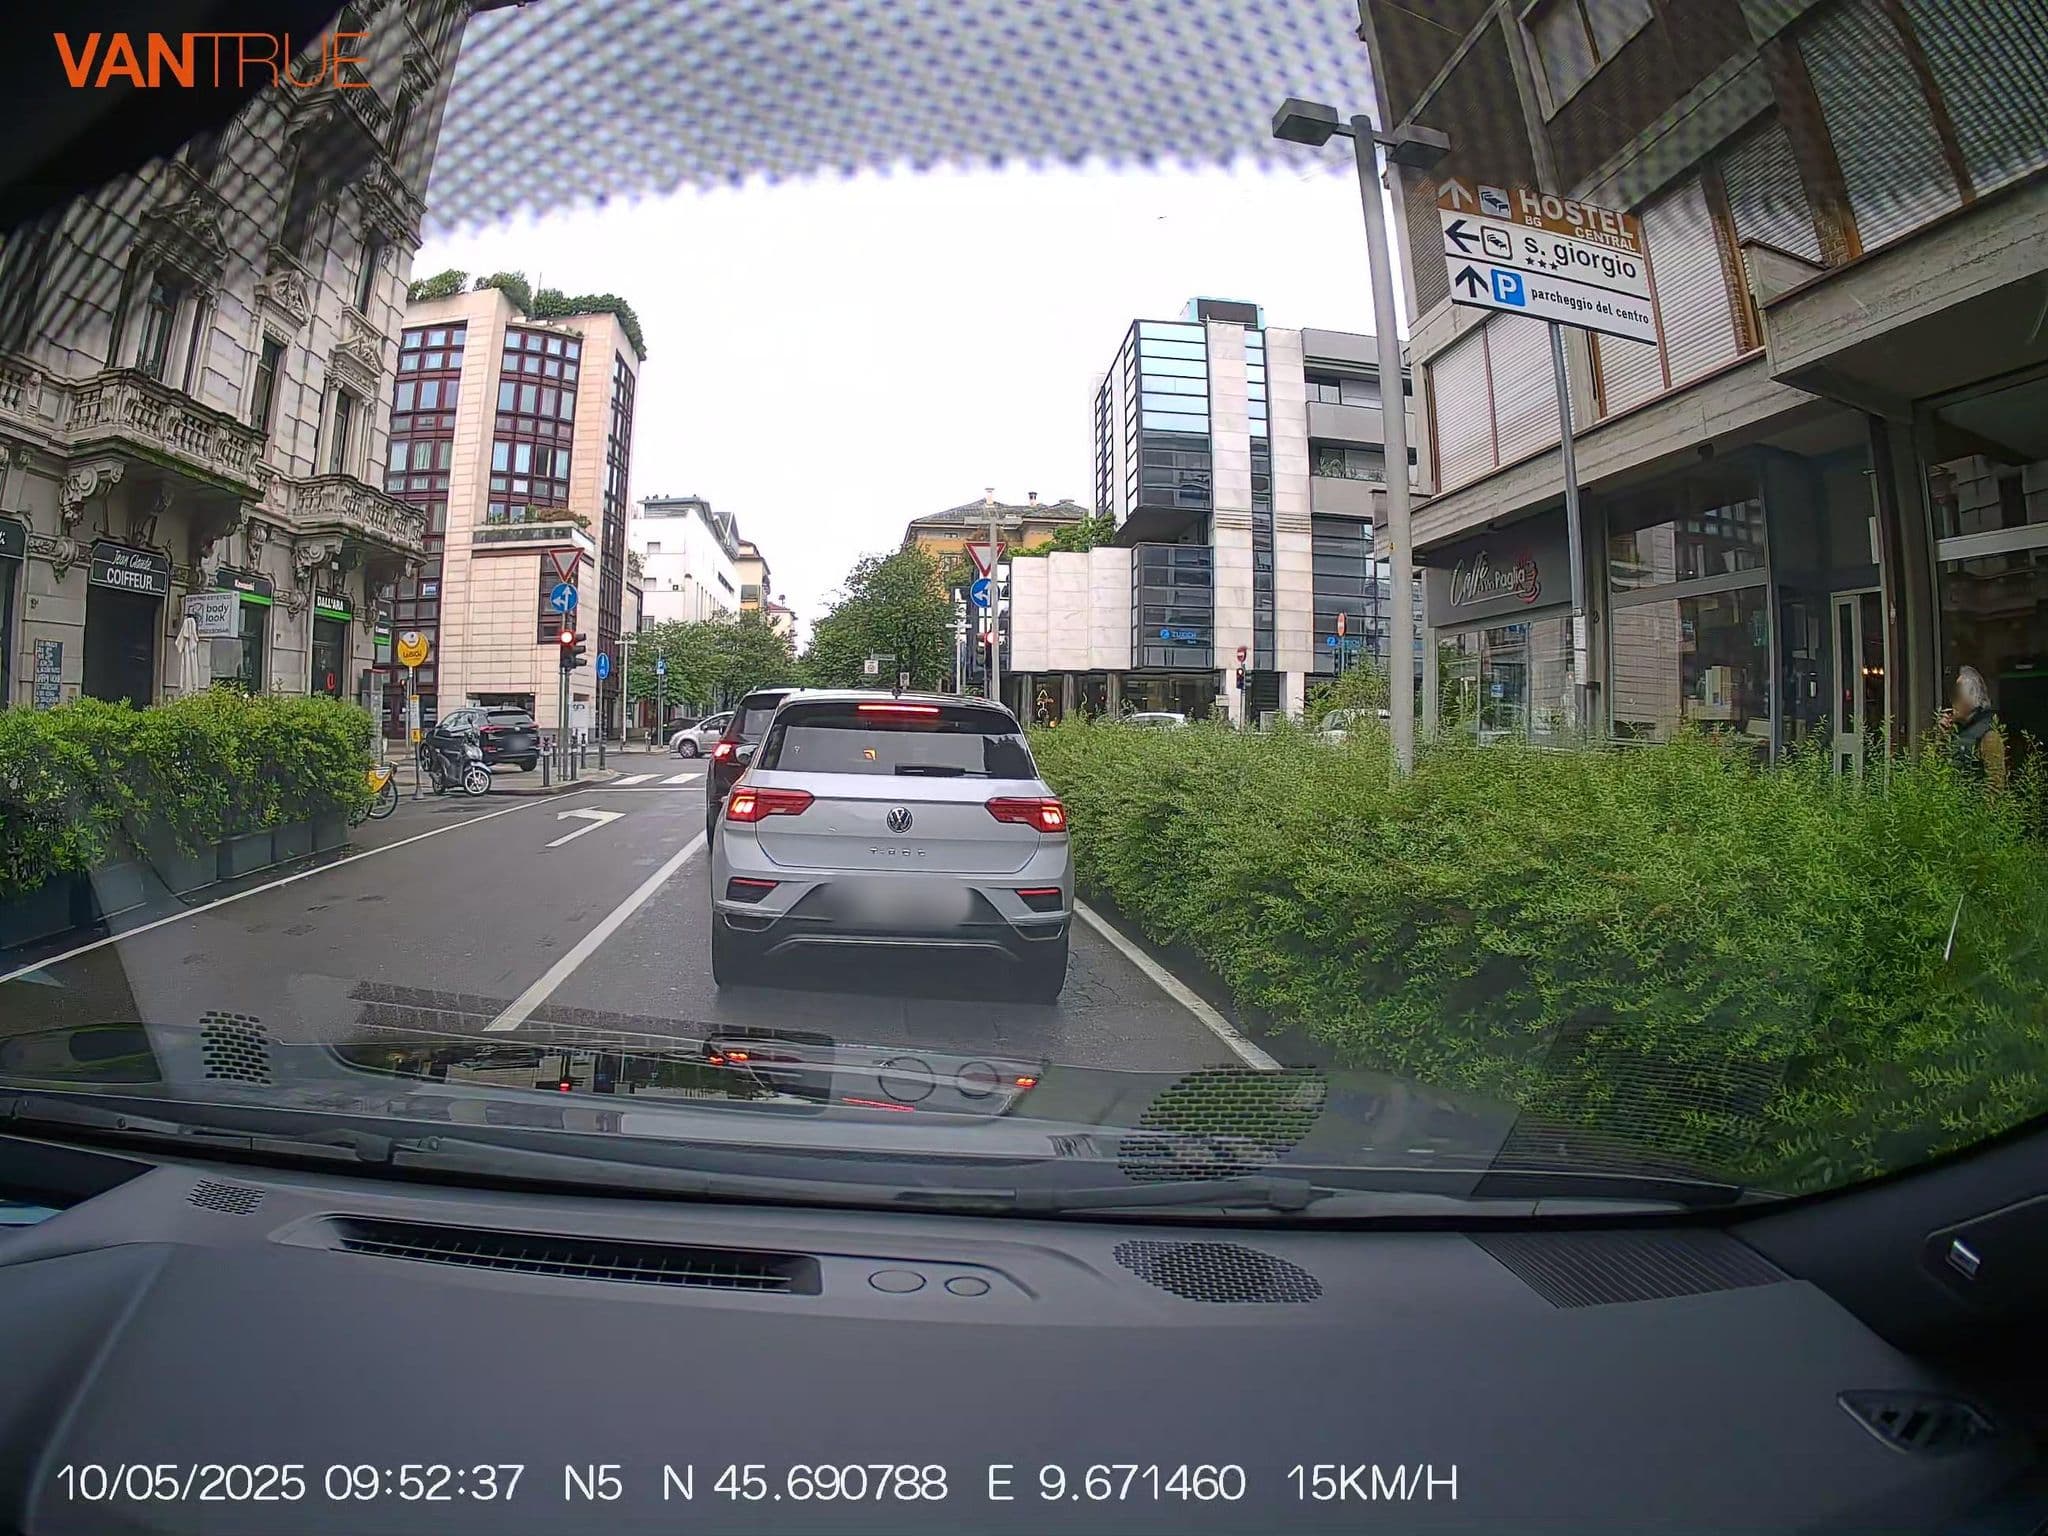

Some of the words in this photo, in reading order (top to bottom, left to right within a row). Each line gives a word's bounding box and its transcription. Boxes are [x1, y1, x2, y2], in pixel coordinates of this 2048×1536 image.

[1518, 188, 1634, 239] HOSTEL
[1525, 214, 1542, 228] BG
[1574, 226, 1637, 251] CENTRAL
[1553, 242, 1637, 279] giorgio
[1531, 288, 1593, 311] parcheggio
[1596, 301, 1613, 316] del
[1616, 308, 1649, 324] centro
[107, 567, 152, 591] COIFFEUR
[205, 613, 225, 622] look
[206, 603, 230, 614] body
